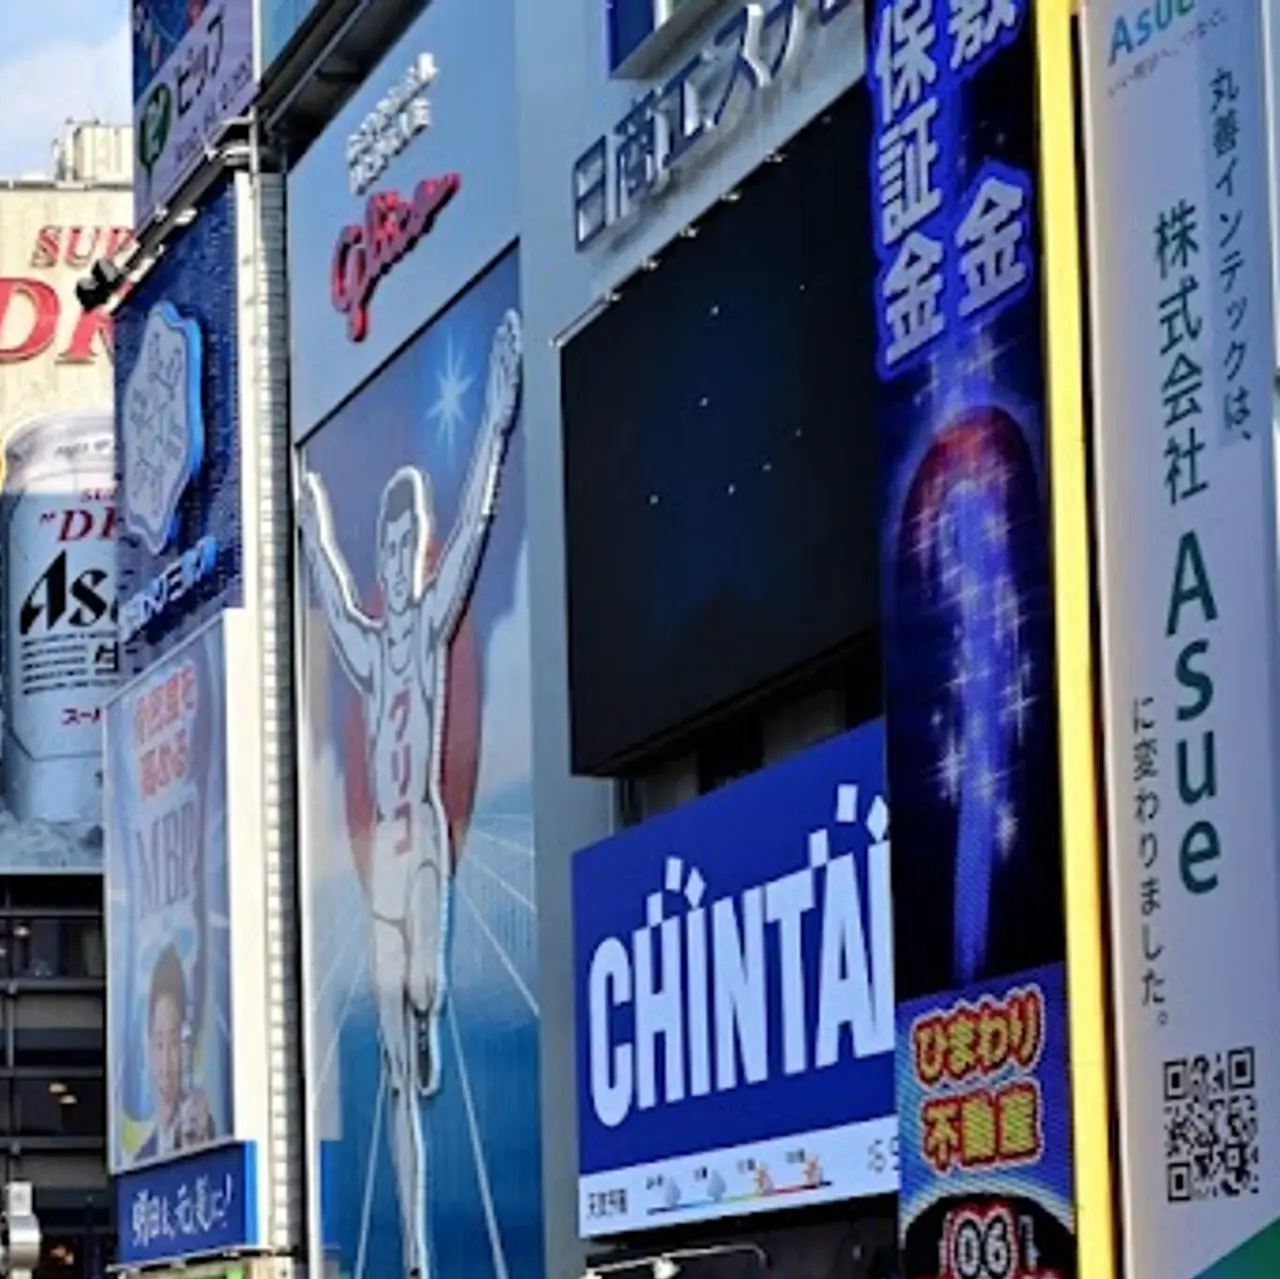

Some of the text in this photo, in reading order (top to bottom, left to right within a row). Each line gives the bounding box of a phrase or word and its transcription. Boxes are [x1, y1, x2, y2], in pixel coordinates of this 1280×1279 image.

[875, 0, 944, 367] 保証金
[19, 550, 118, 636] As
[1153, 198, 1222, 897] 株式会社 Asue
[388, 674, 413, 857] グリコ
[1131, 696, 1168, 1027] に変わりました。
[588, 838, 895, 1128] CHINTAI
[914, 988, 1043, 1083] ひまわり
[922, 1084, 1043, 1171] 不動産
